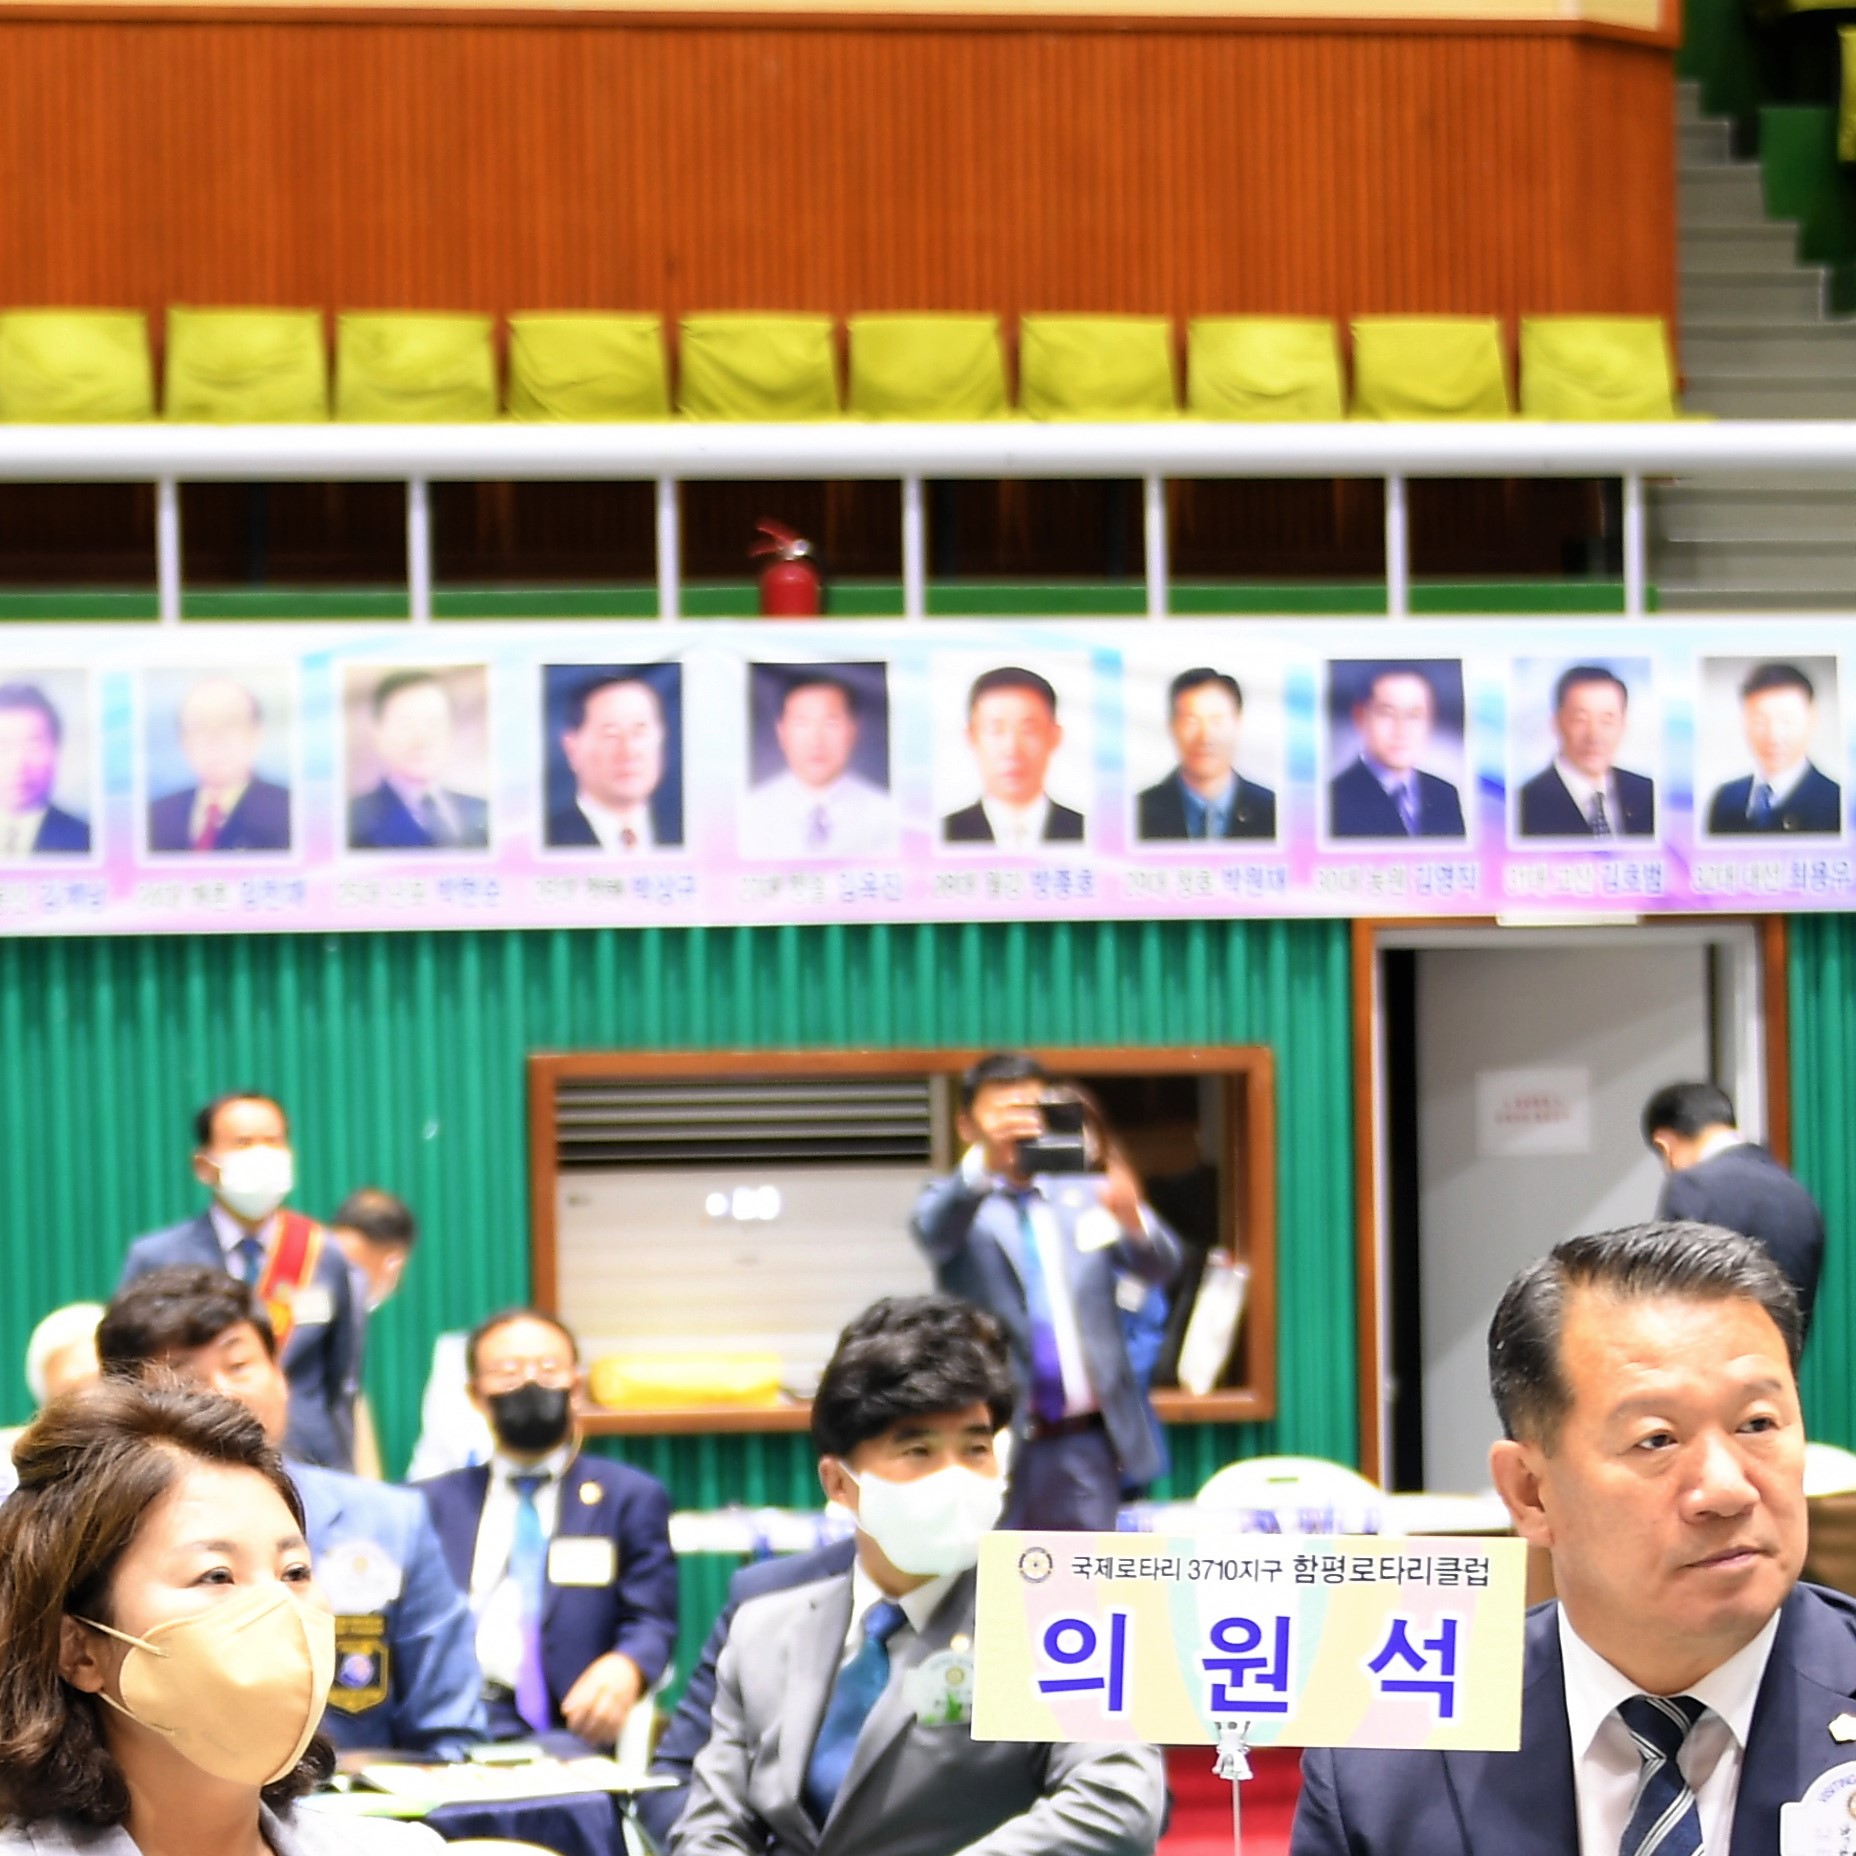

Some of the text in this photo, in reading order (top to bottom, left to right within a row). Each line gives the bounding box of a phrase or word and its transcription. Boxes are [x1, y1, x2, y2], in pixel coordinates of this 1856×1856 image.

[1070, 1553, 1491, 1587] 국제로타리 3710지구 함평로타리클럽
